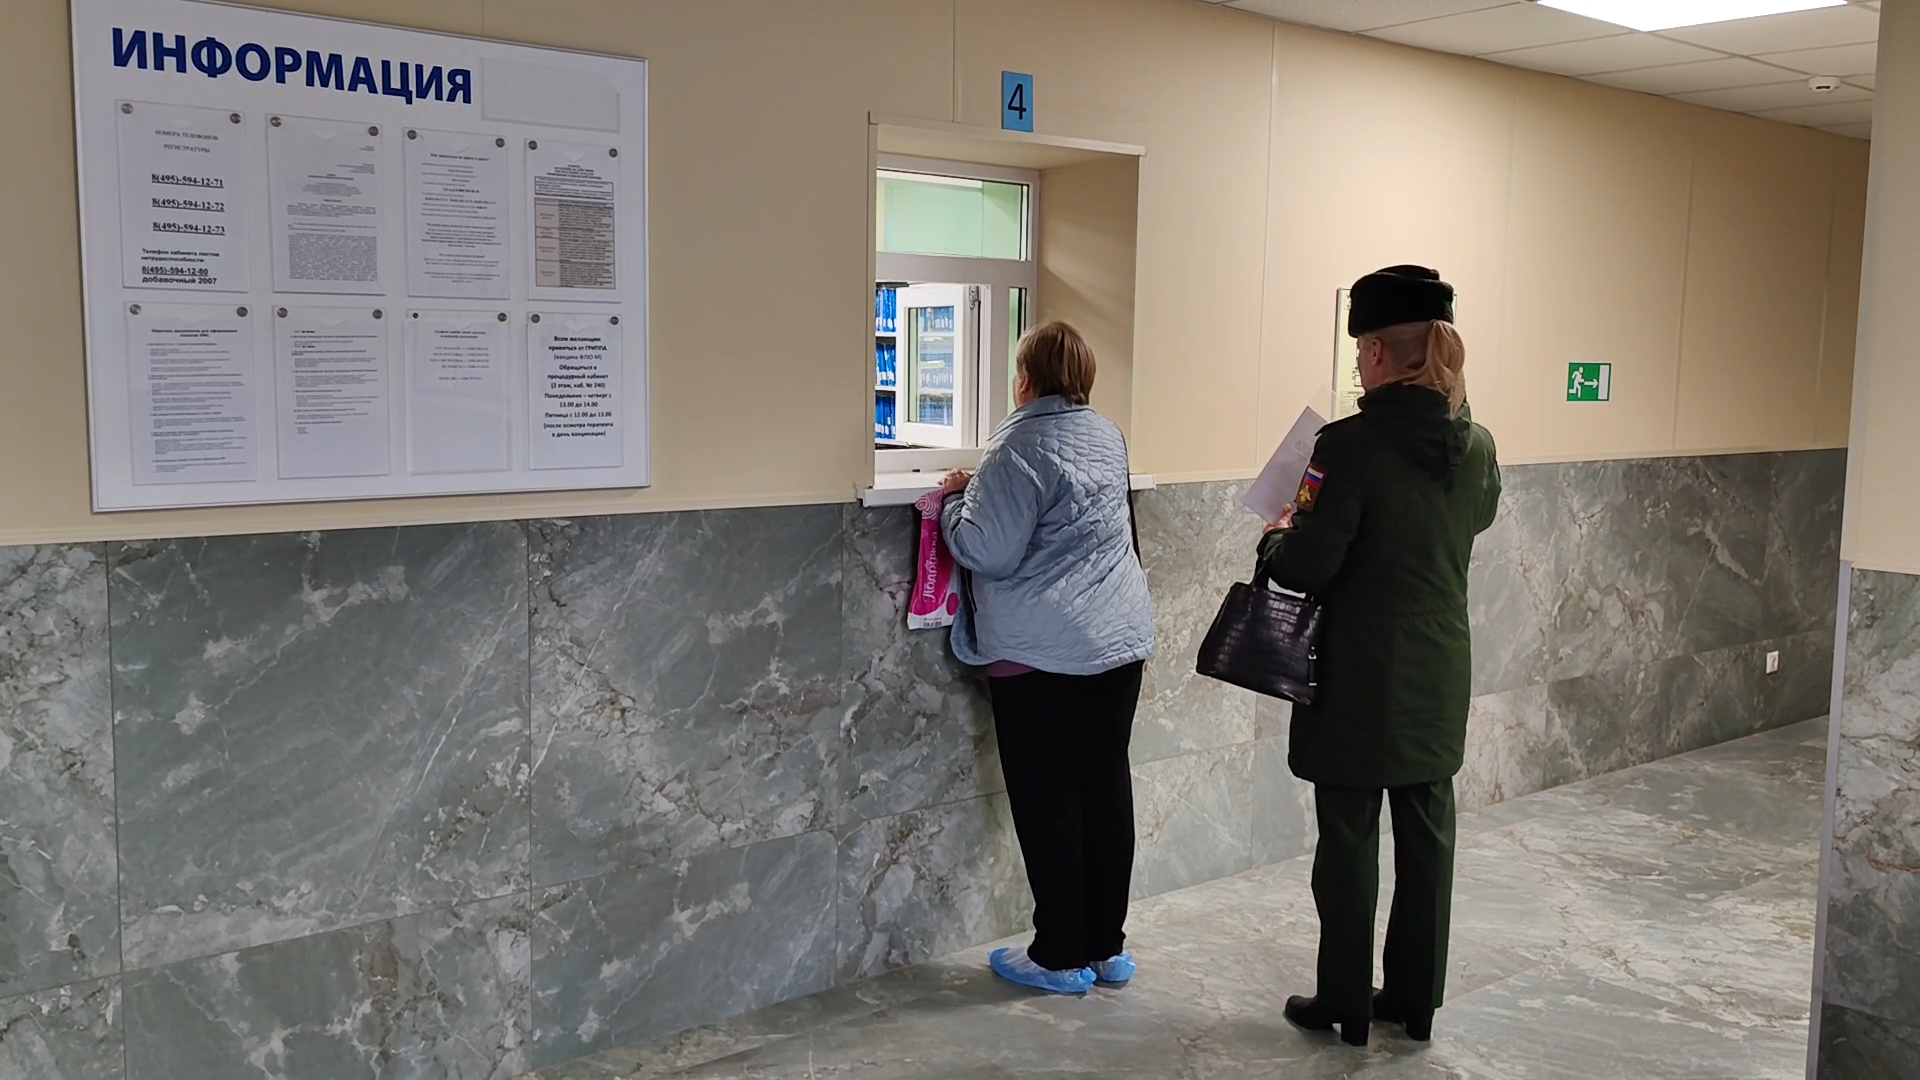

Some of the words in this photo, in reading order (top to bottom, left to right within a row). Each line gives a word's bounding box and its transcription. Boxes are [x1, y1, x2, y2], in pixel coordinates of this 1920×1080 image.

[112, 27, 472, 105] ИНФОРМАЦИЯ
[1007, 83, 1027, 120] 4
[182, 132, 218, 140] ТЕЛЕФОНОВ
[164, 143, 210, 153] РЕГИСТРАТУРЫ
[151, 173, 224, 189] 8(495)-594-12-71
[152, 198, 225, 212] 8(495)-594-12-72
[153, 222, 225, 236] 8(495)-594-12-73
[142, 276, 196, 284] добавочный
